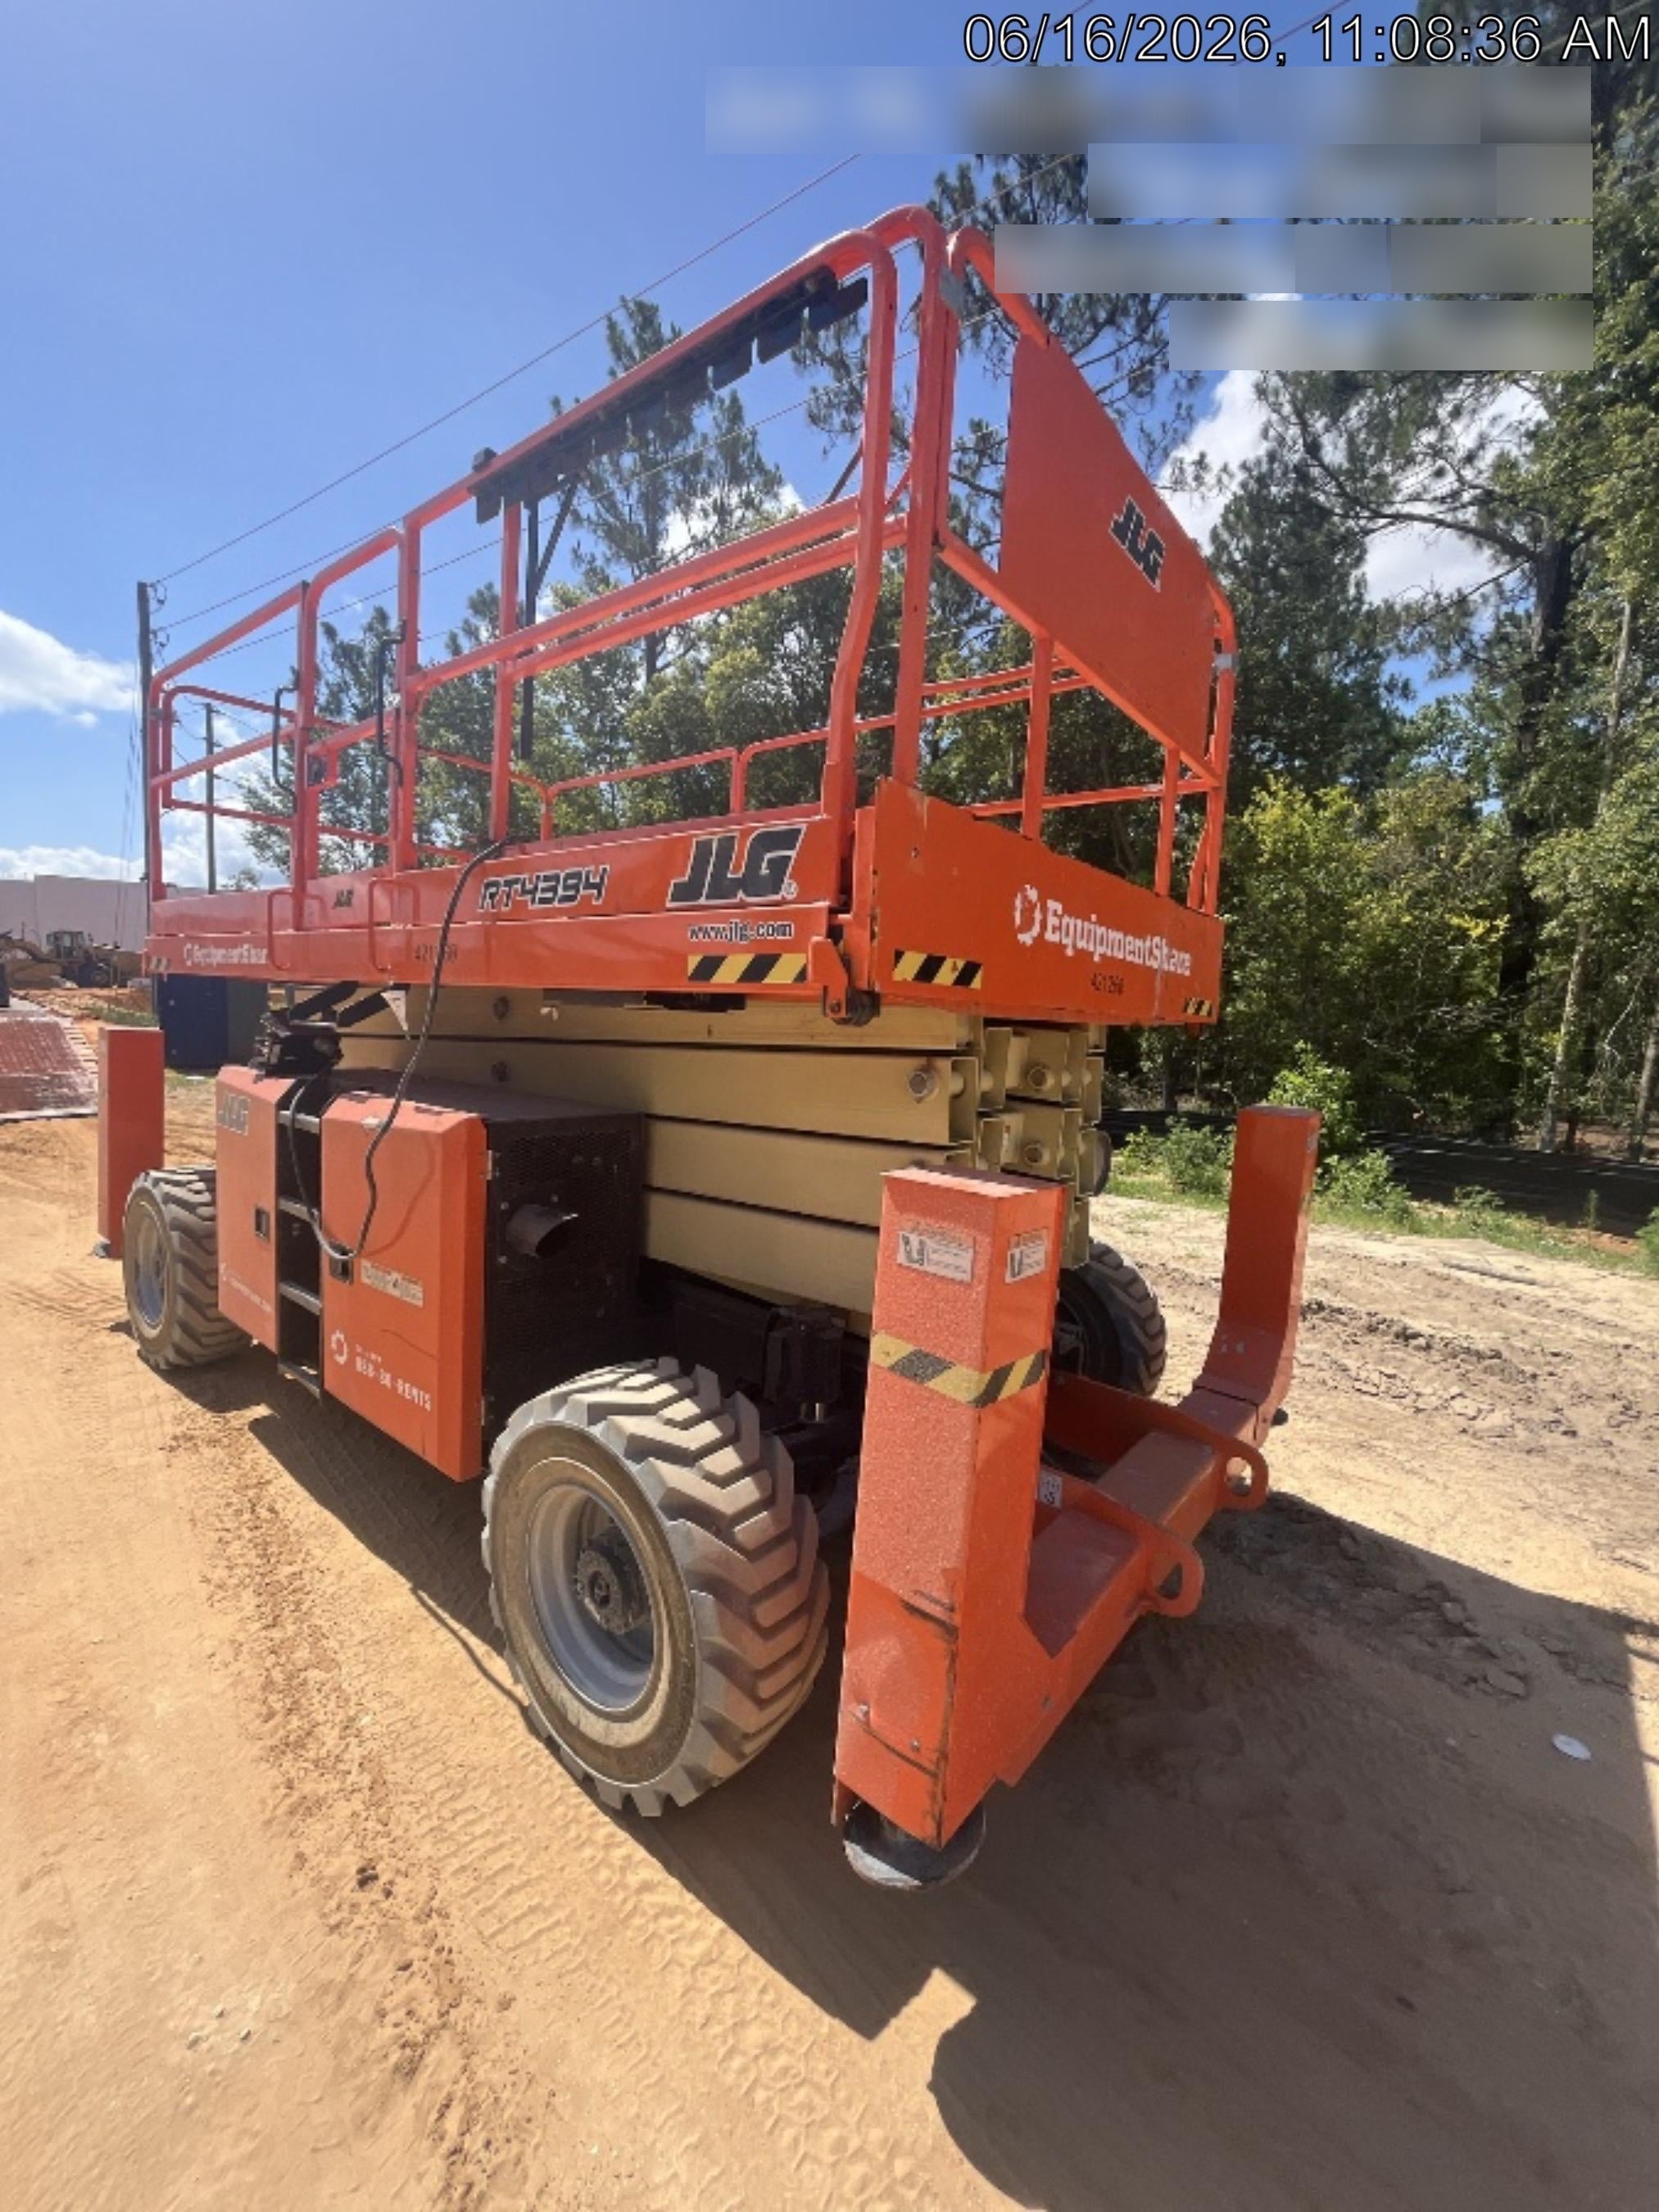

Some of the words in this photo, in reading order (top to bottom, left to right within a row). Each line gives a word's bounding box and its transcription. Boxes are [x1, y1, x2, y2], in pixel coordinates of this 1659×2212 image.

[1108, 495, 1165, 592] JLG
[478, 864, 610, 912] RT4394
[666, 824, 807, 908] JLG
[687, 918, 794, 943] www.jlg.com
